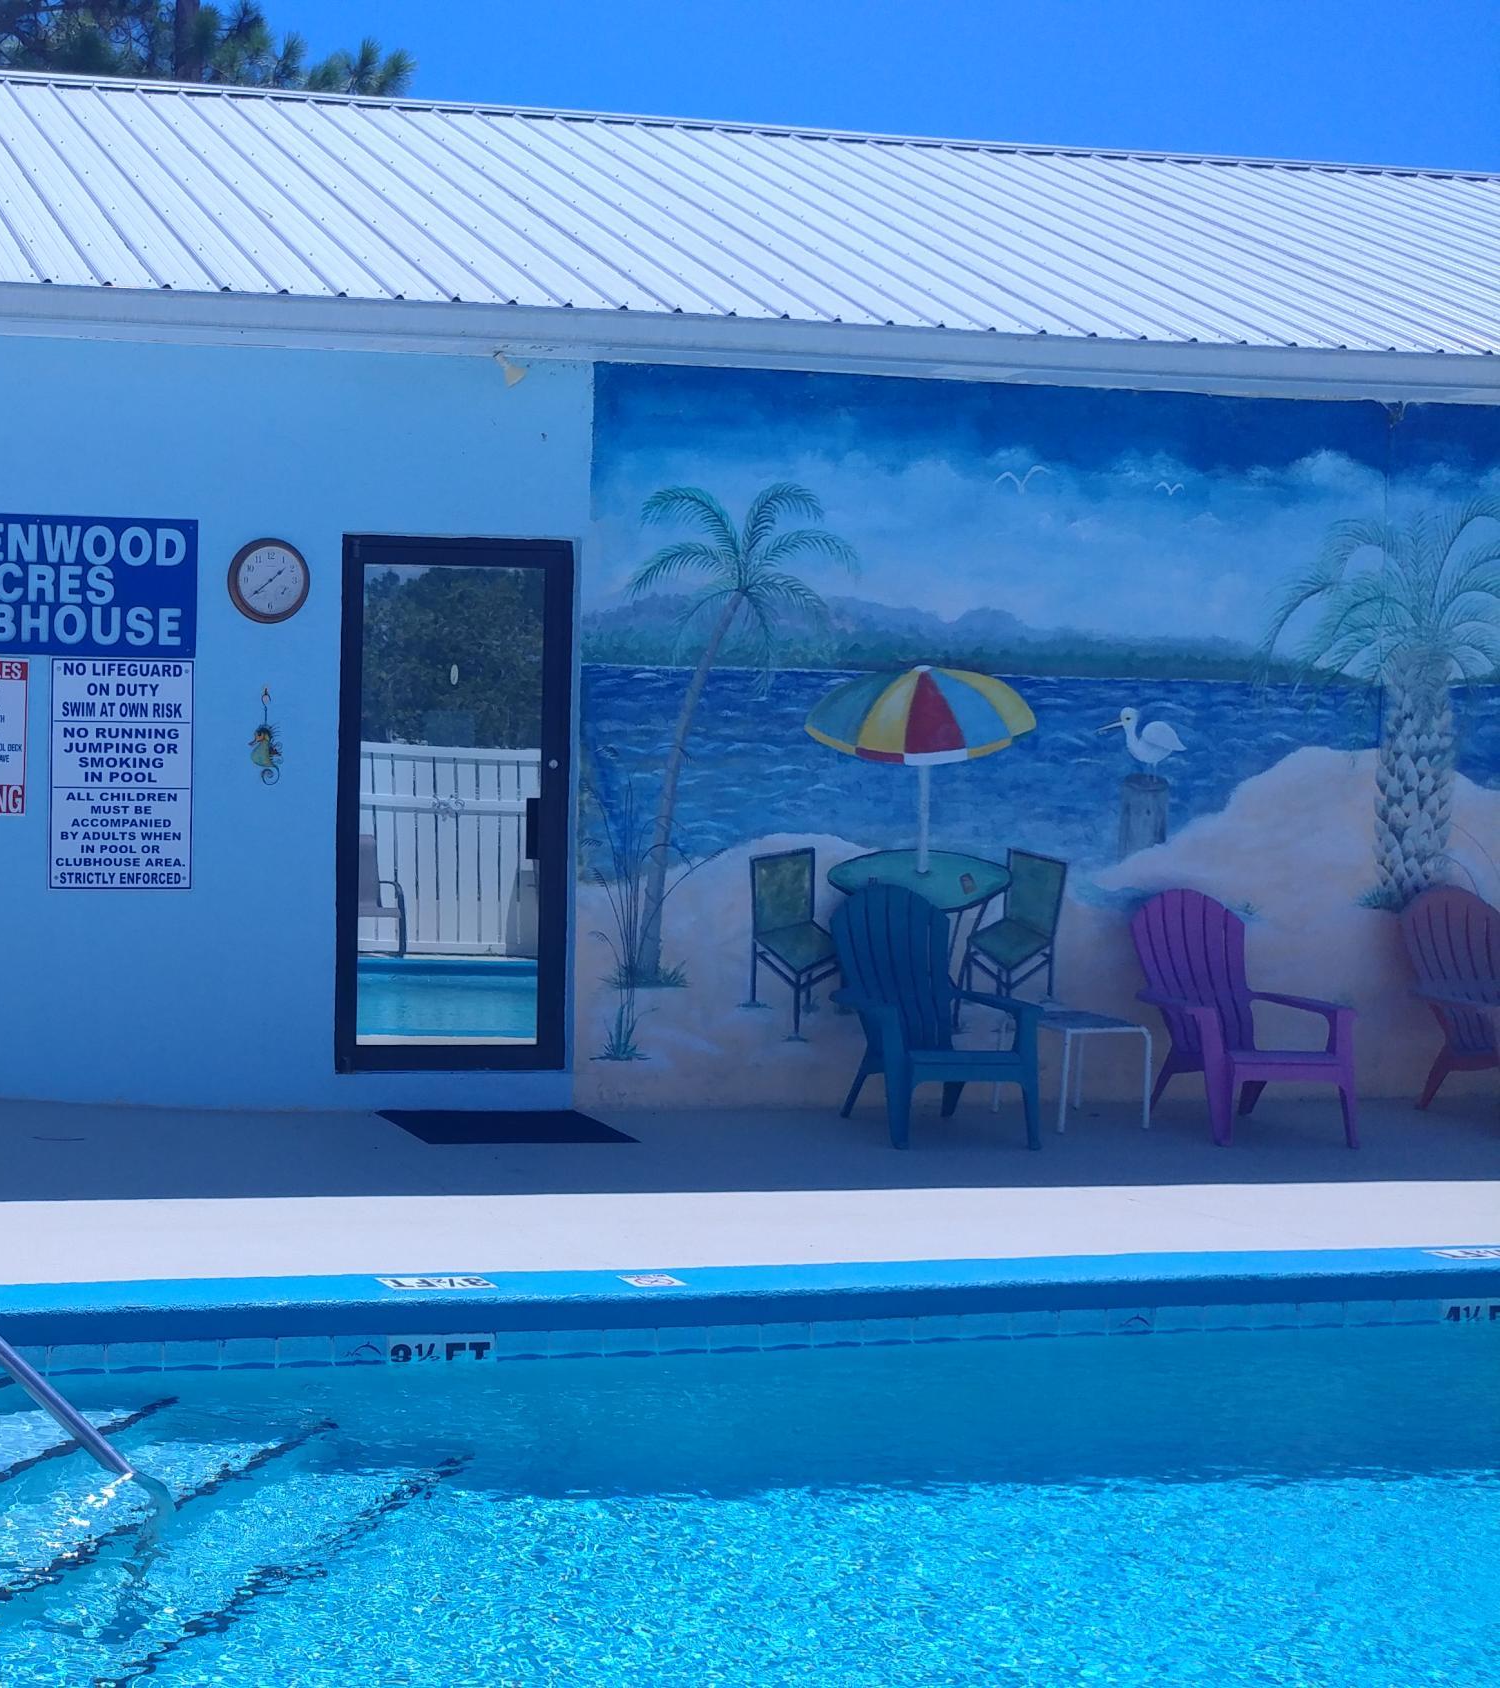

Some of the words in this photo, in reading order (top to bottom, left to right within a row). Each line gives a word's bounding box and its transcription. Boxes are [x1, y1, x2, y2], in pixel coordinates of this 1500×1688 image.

[267, 552, 276, 560] 12
[63, 662, 87, 677] NO
[92, 662, 183, 678] LIFEGUARD
[87, 682, 110, 697] ON
[115, 683, 160, 697] DUTY
[62, 701, 96, 718] SWIM
[99, 702, 116, 718] AT
[119, 702, 148, 718] OWN
[152, 703, 183, 719] RISK
[63, 727, 89, 739] NO
[95, 727, 180, 740] RUNNING
[7, 743, 23, 753] DECK
[63, 742, 148, 755] JUMPING
[153, 743, 179, 755] OR
[78, 757, 165, 769] SMOKING
[84, 771, 103, 783] IN
[109, 772, 158, 783] POOL
[66, 792, 94, 801] ALL
[99, 792, 178, 802] CHILDREN
[90, 805, 130, 815] MUST
[134, 806, 152, 815] BE
[71, 818, 172, 828] ACCOMPANIED
[60, 831, 78, 841] BY
[82, 831, 136, 841] ADULTS
[141, 832, 182, 841] WHEN
[80, 844, 95, 854] IN
[100, 844, 137, 854] POOL
[141, 845, 161, 854] OR
[55, 857, 141, 867] CLUBHOUSE
[144, 858, 186, 867] AREA.
[60, 872, 116, 885] STRICTLY
[119, 873, 181, 885] ENFORCED
